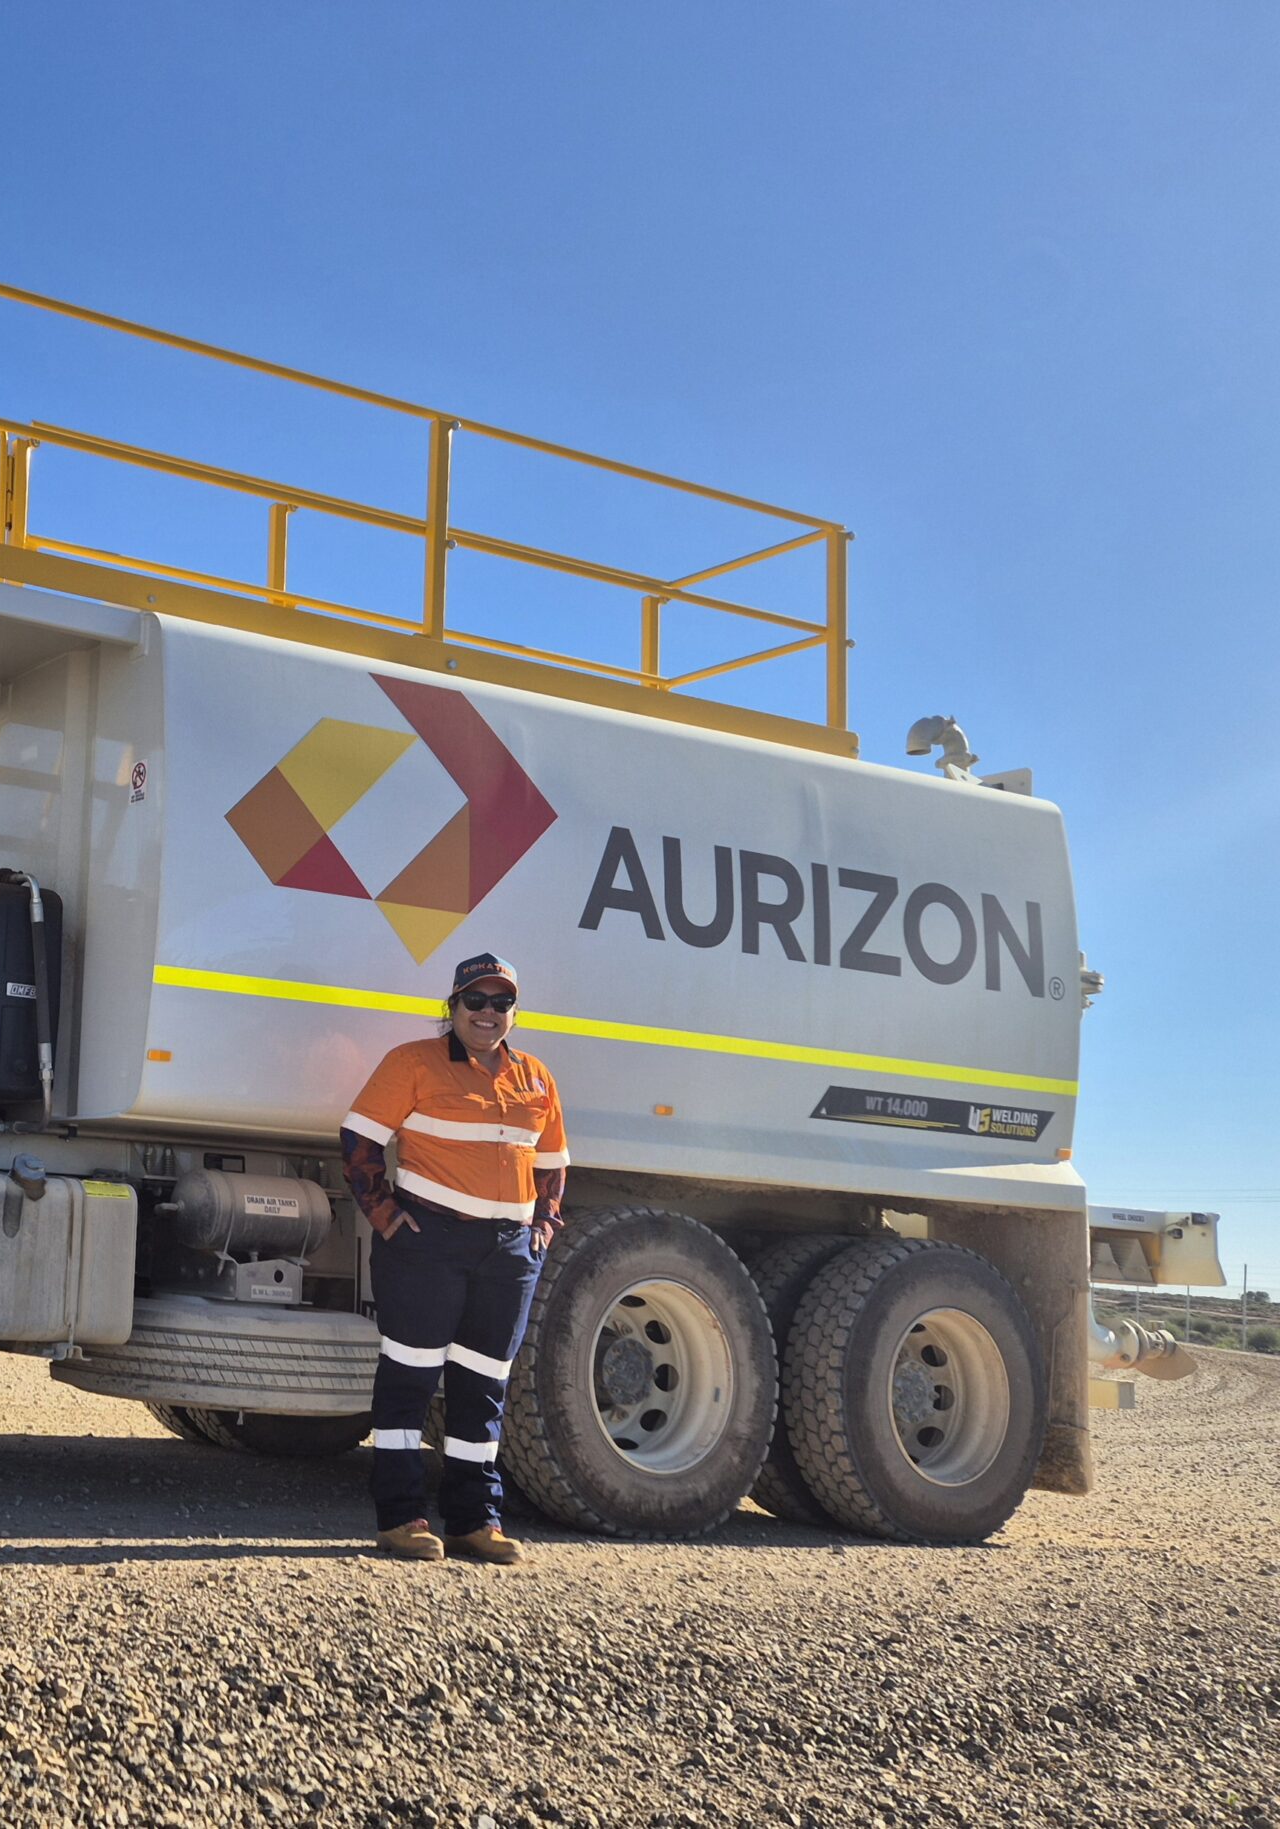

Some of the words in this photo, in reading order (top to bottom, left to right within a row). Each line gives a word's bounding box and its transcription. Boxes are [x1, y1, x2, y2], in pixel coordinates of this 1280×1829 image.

[578, 825, 1046, 998] AURIZON
[865, 1095, 882, 1111] WT
[992, 1108, 1039, 1126] WELDING
[990, 1122, 1037, 1138] SOLUTIONS
[246, 1196, 265, 1205] DRAIN
[267, 1197, 277, 1206] AIR
[278, 1198, 297, 1208] TANKS
[264, 1205, 281, 1215] DAILY
